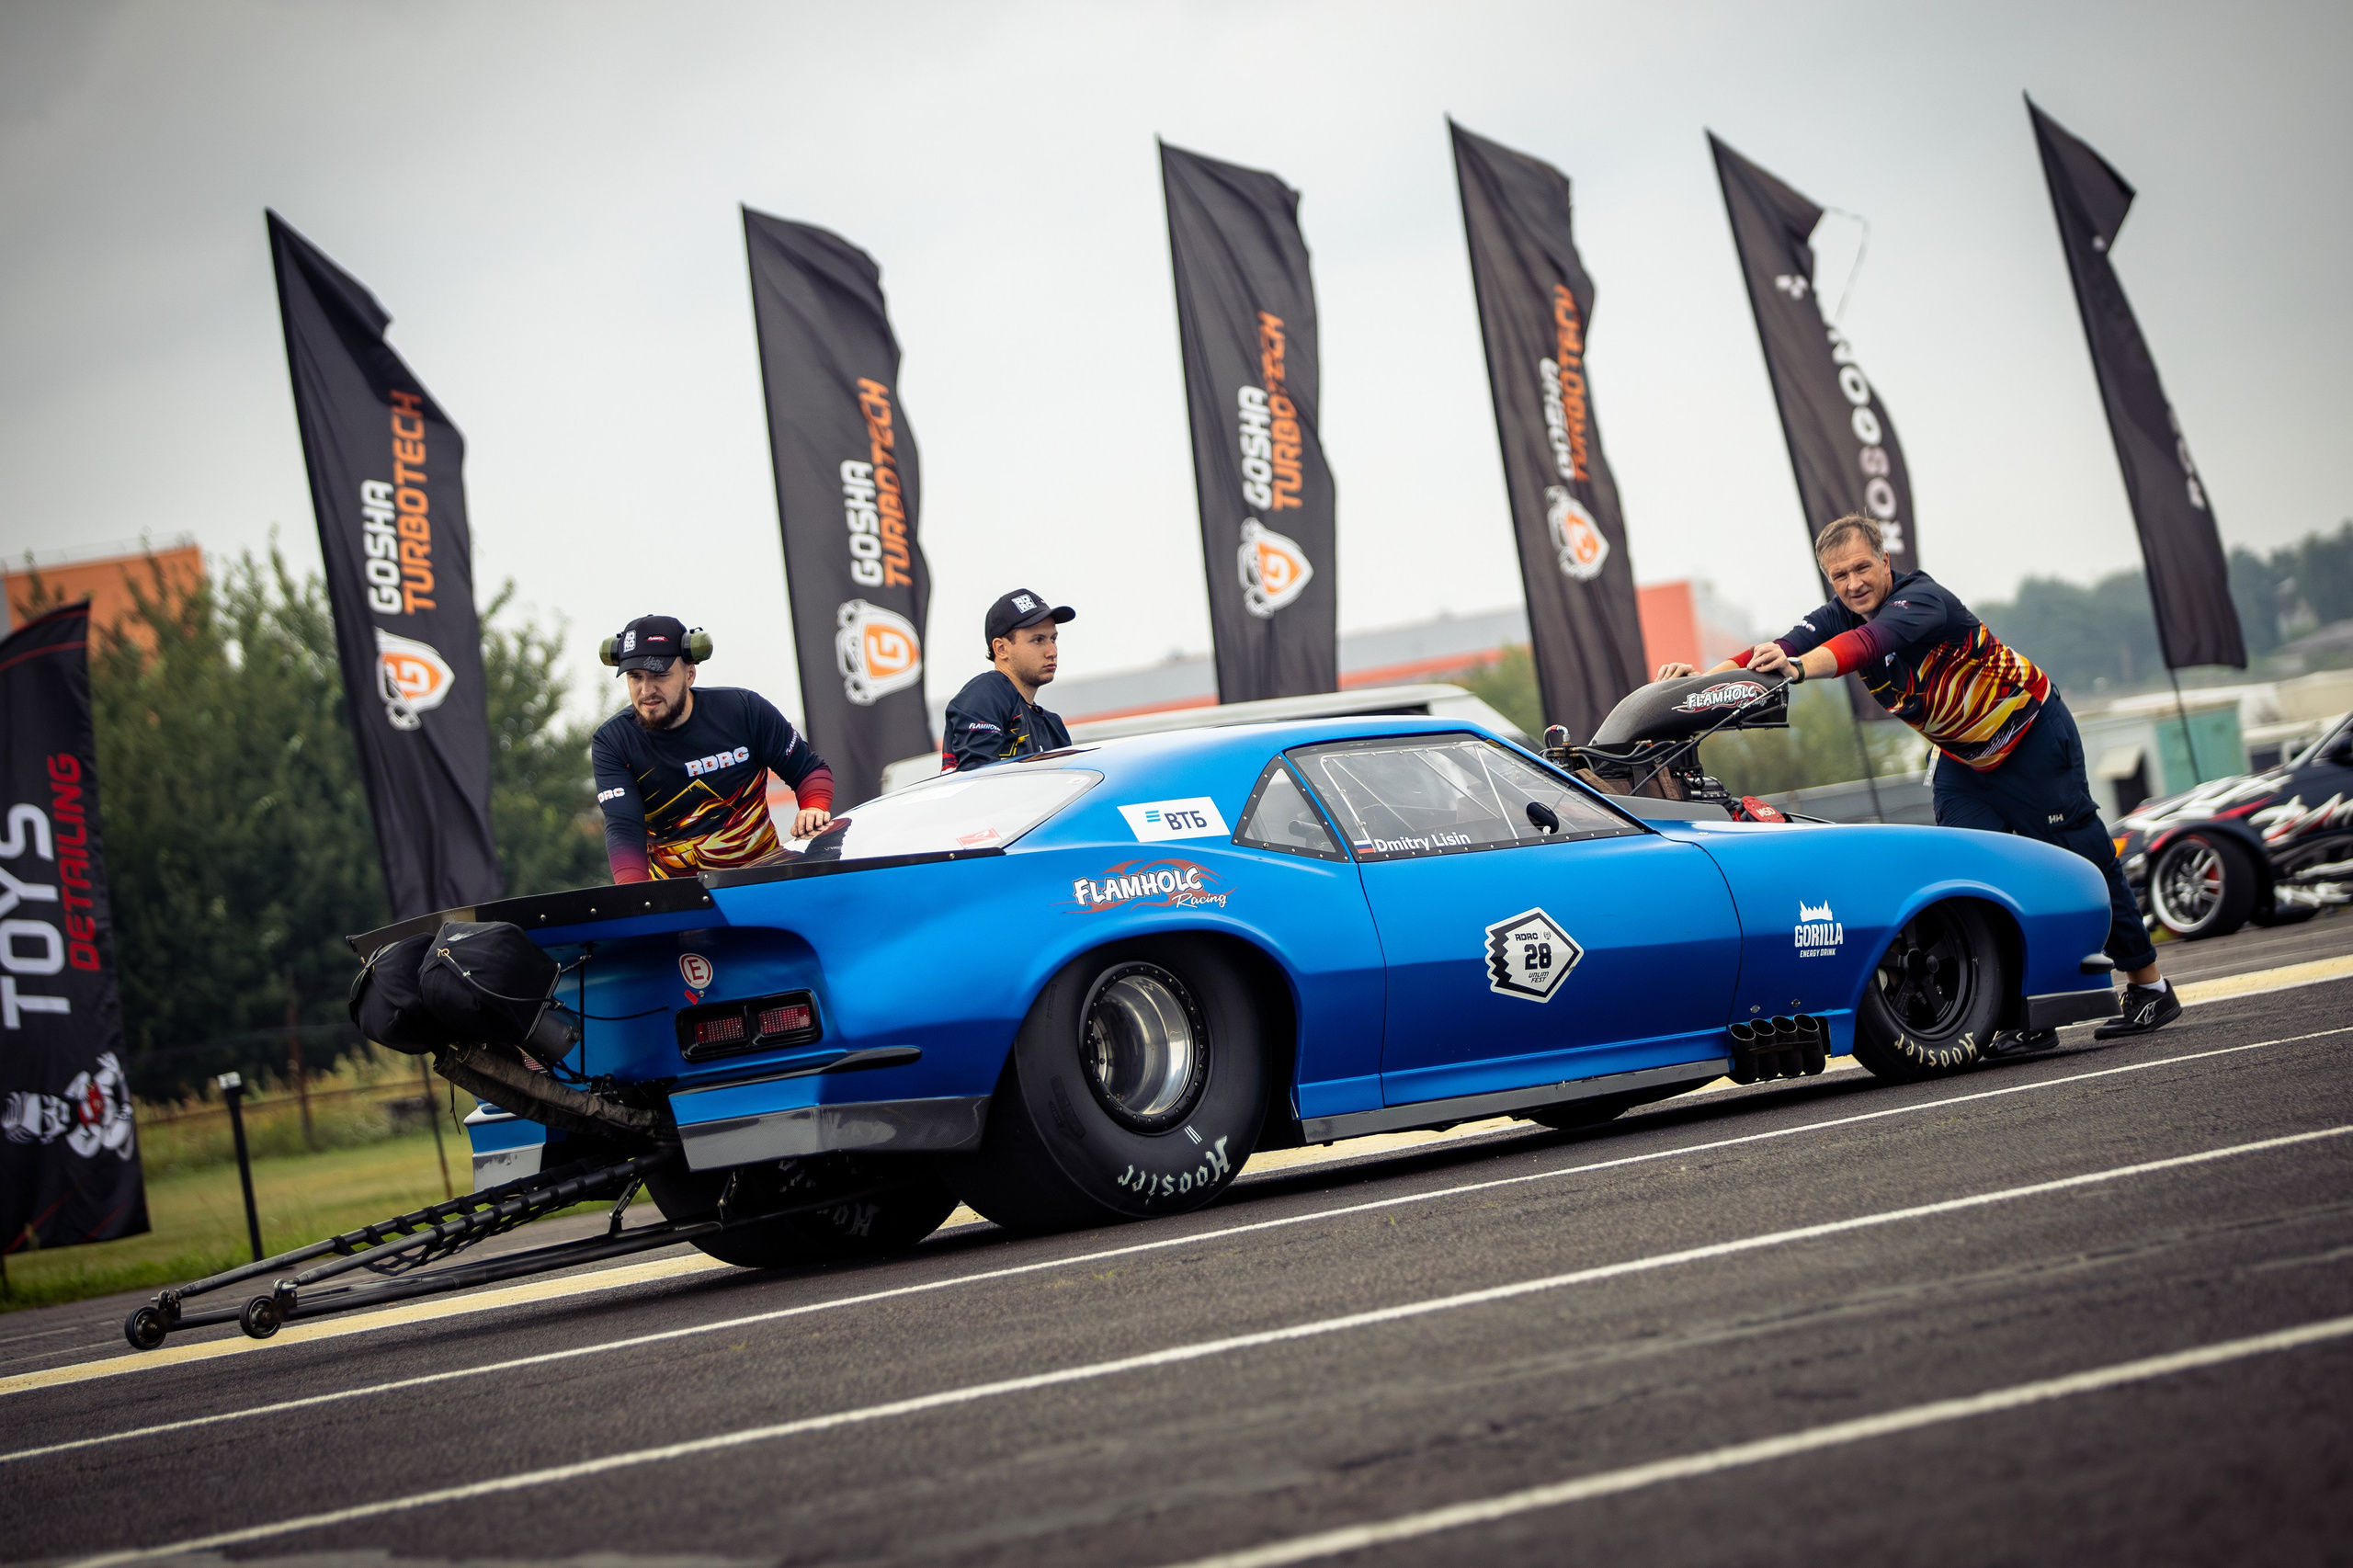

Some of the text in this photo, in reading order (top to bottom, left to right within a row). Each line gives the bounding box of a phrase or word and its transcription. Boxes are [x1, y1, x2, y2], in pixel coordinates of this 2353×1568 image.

[1257, 310, 1302, 511] TURBOTECH
[1237, 384, 1273, 511] GOSHA
[857, 377, 913, 588] TURBOTECH
[390, 390, 437, 616] TURBOTECH
[839, 460, 884, 587] GOSHA
[360, 479, 403, 615] GOSHA
[1687, 685, 1756, 709] FLAMHOLC
[684, 746, 750, 778] RDRC
[1164, 810, 1208, 831] ВТБ
[1756, 806, 1776, 818] MSD
[2048, 813, 2064, 824] HH
[1373, 831, 1472, 852] Dmitry Lisin
[48, 753, 100, 971] DETAILING
[1073, 865, 1204, 906] FLAMHOLC
[1171, 892, 1228, 908] Racing
[0, 802, 71, 1030] TOYS
[1514, 932, 1539, 942] RDRC
[1794, 922, 1844, 948] GORILLA
[1524, 942, 1552, 971] 28
[1800, 948, 1836, 958] ENERGY DRINK
[687, 958, 705, 981] E
[1893, 1031, 1978, 1067] Hoosier
[1117, 1135, 1232, 1206] Hoosier
